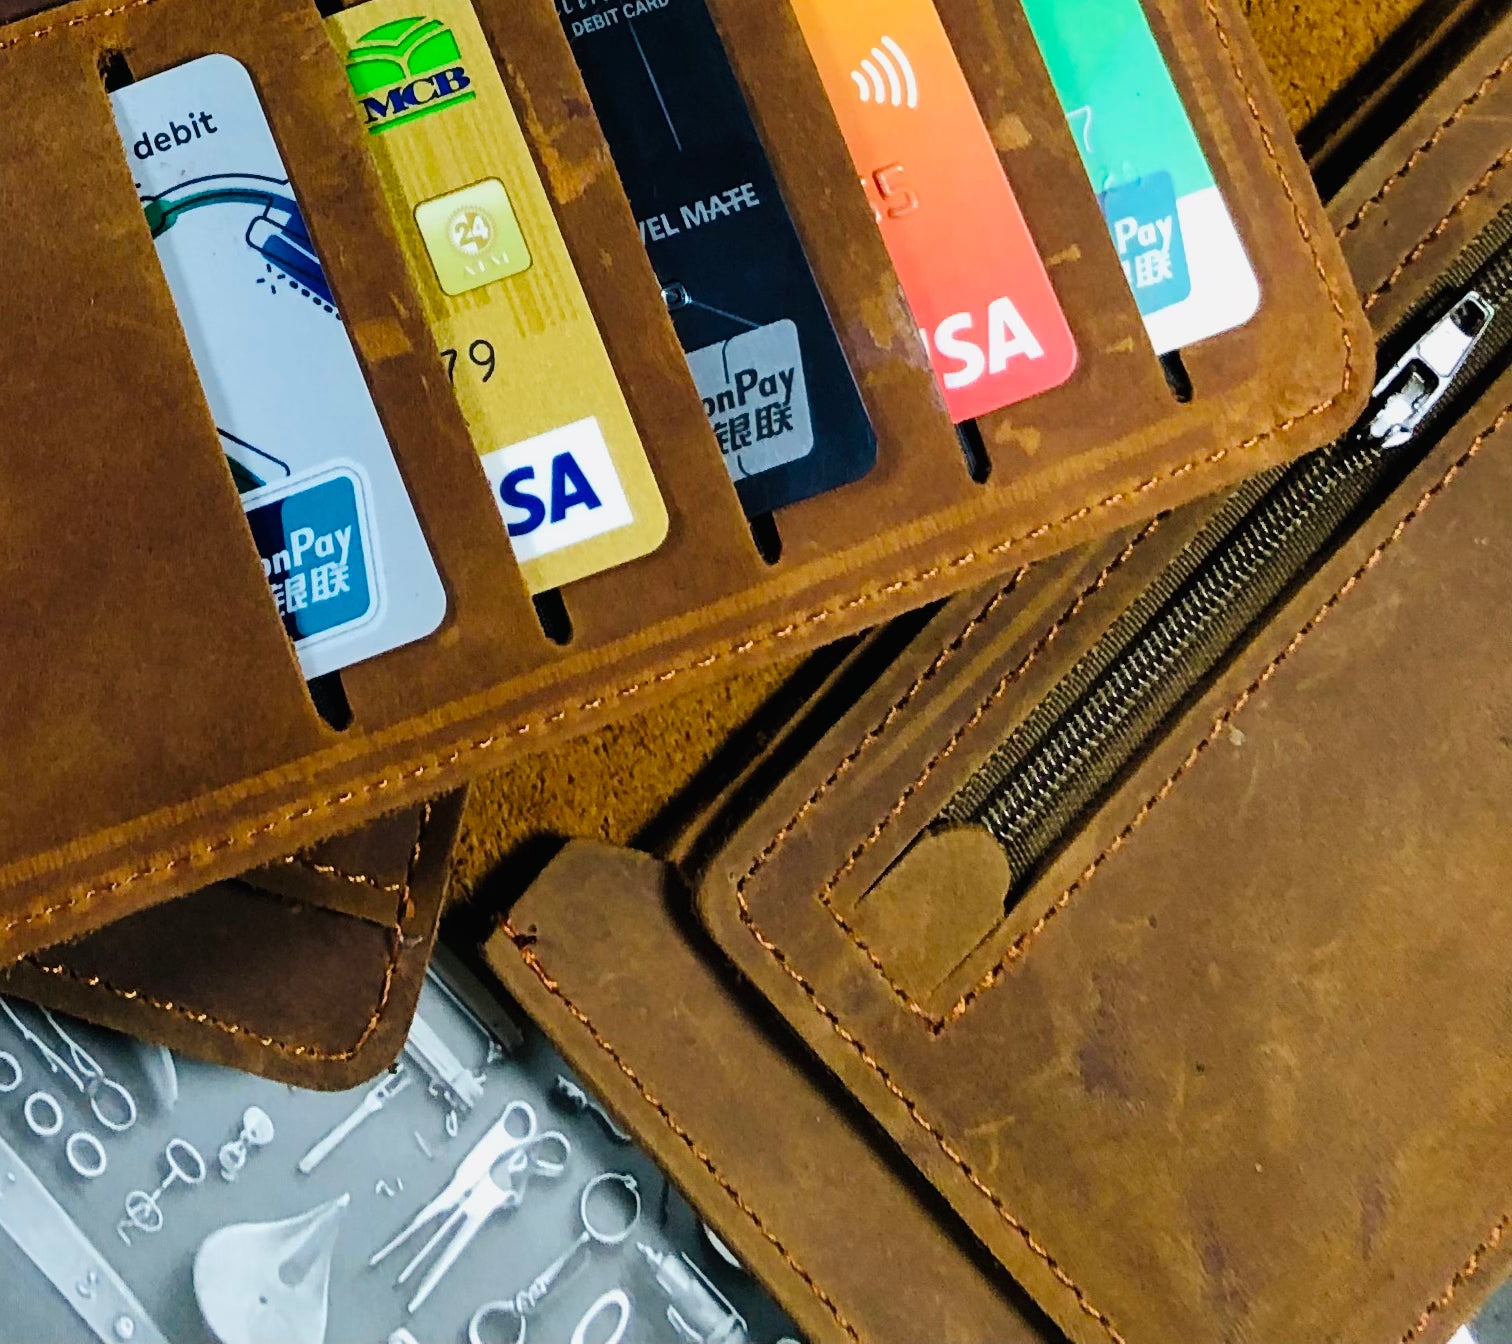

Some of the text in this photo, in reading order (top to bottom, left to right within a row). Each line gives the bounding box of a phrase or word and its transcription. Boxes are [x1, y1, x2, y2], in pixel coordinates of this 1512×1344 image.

[571, 7, 618, 38] DEBIT
[359, 66, 471, 124] MCB
[134, 111, 217, 160] debit
[680, 182, 760, 229] MATE
[860, 162, 919, 221] 5
[1114, 215, 1173, 254] Pay
[1121, 249, 1173, 288] 联
[440, 339, 496, 384] 79
[919, 296, 1044, 389] SA
[713, 401, 793, 454] 银联
[270, 561, 350, 616] 银联
